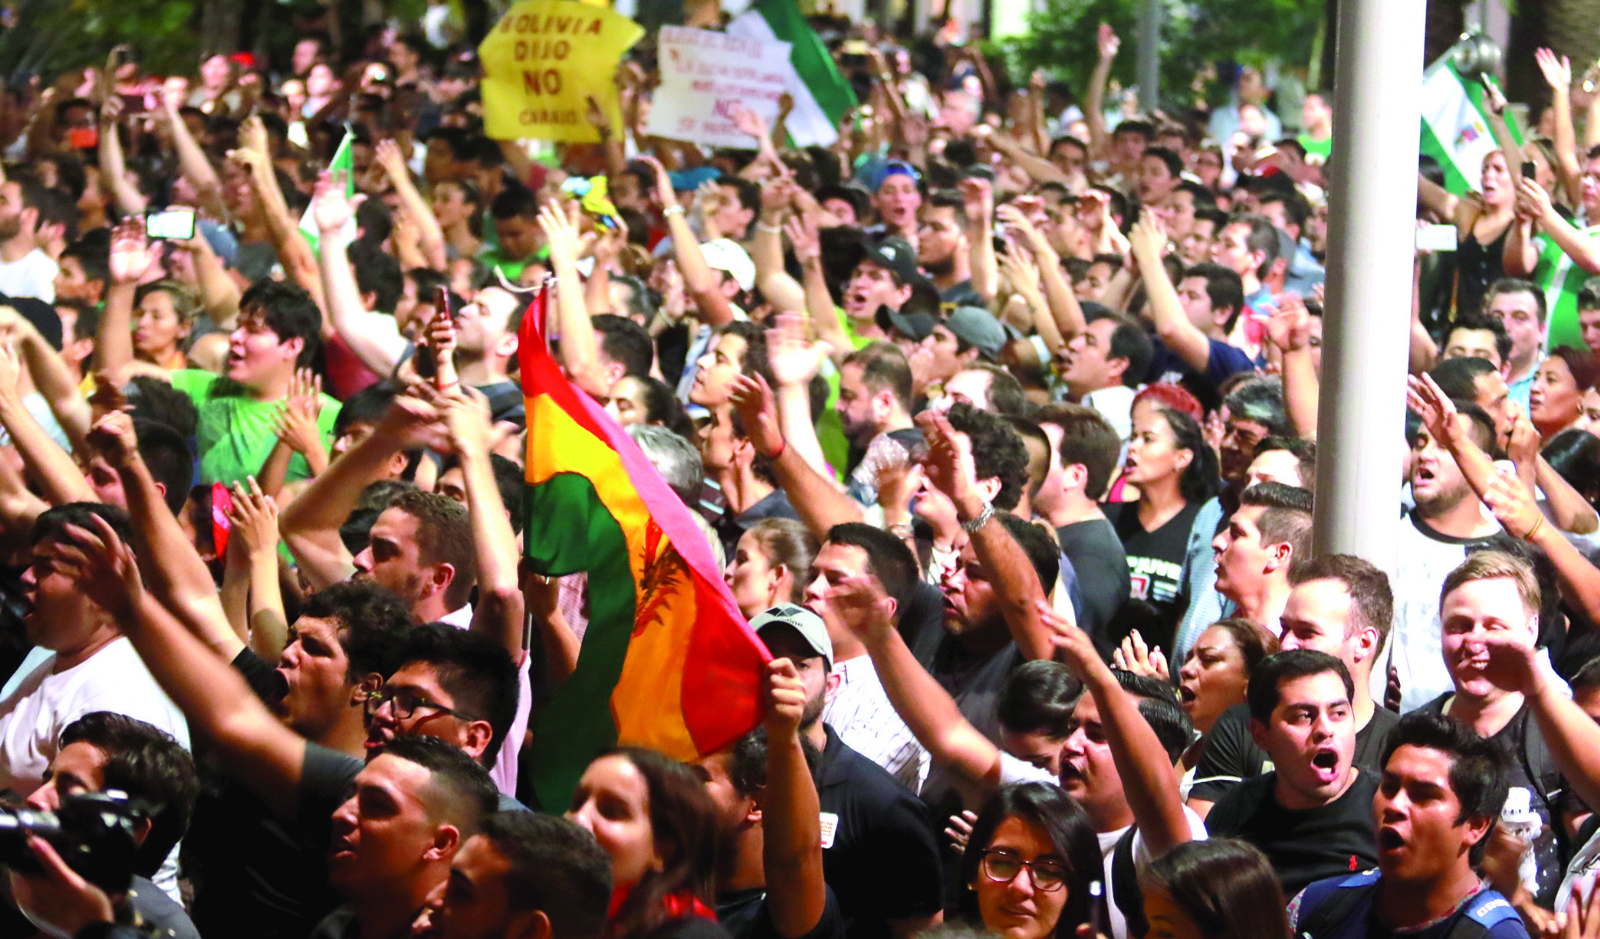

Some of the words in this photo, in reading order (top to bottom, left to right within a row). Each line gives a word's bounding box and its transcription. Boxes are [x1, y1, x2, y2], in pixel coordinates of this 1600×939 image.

[499, 13, 603, 35] BOLIVIA
[514, 39, 572, 62] DIJO
[522, 67, 563, 96] NO
